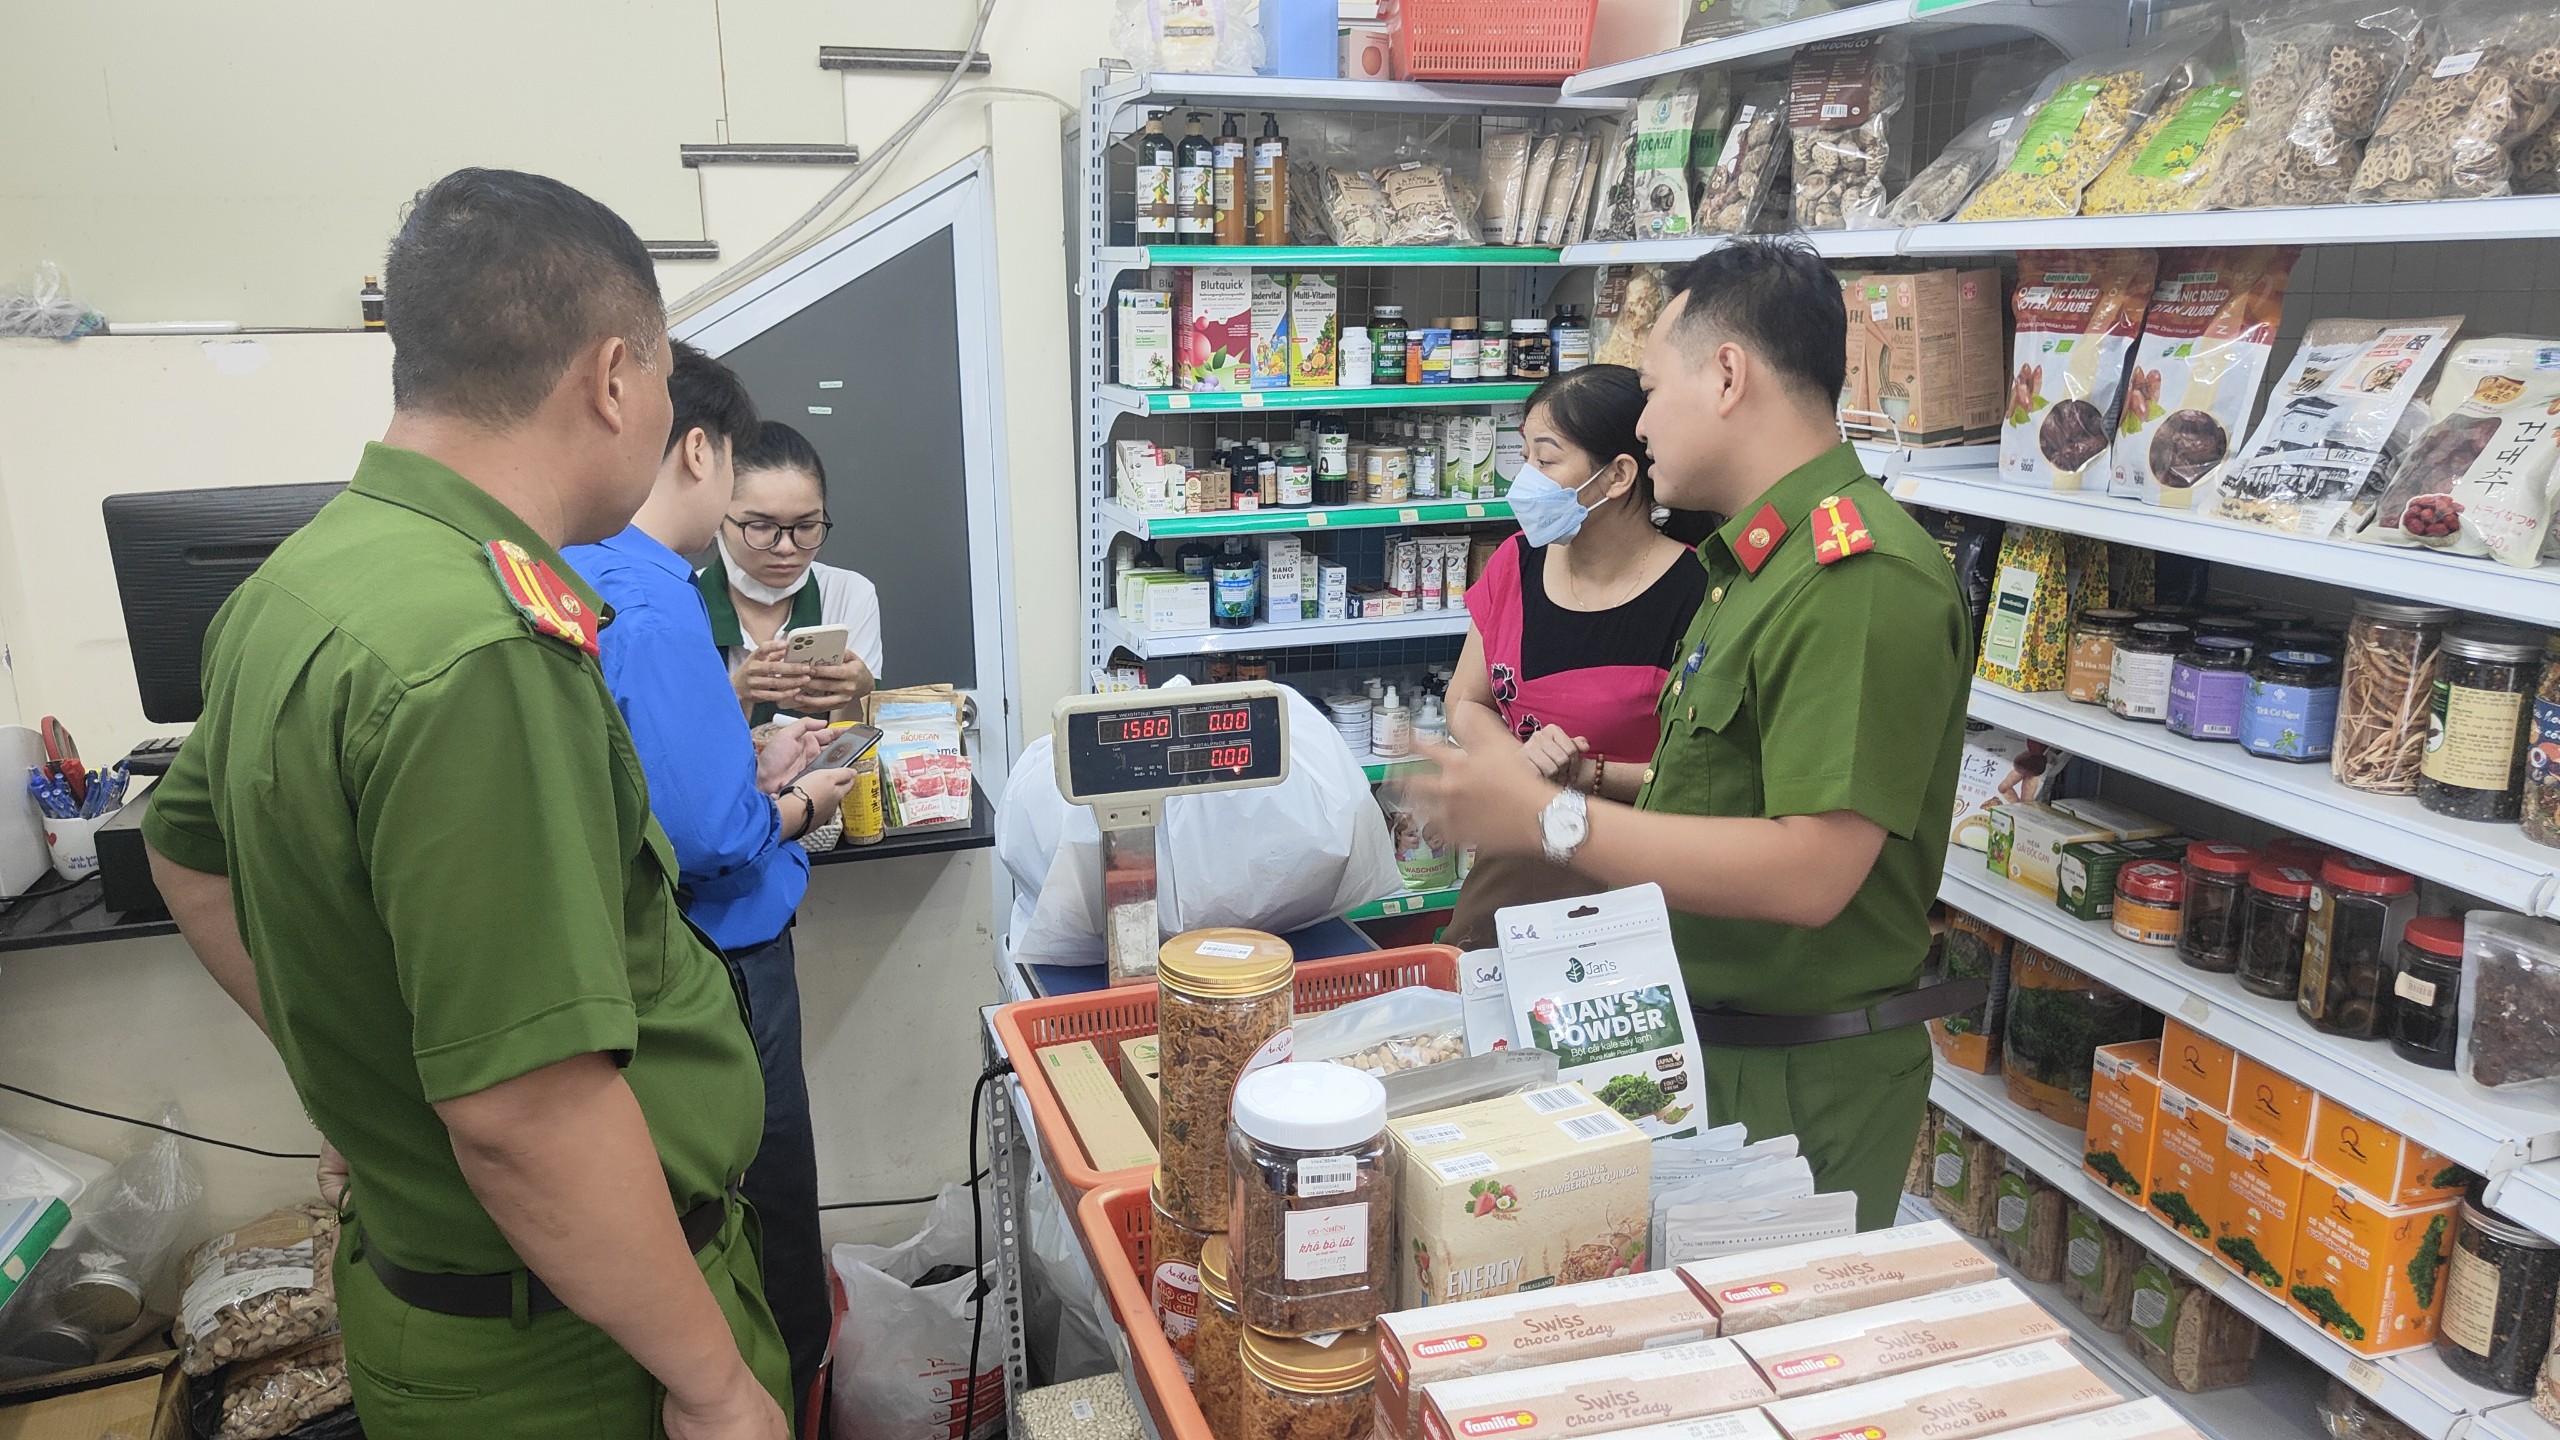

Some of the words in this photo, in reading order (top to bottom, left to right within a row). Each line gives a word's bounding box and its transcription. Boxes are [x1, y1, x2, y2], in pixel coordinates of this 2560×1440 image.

[1201, 280, 1244, 290] Blutquick
[2019, 287, 2068, 298] ONIC
[2068, 288, 2099, 299] DRIED
[1293, 291, 1336, 301] Multi-Vitamin
[2200, 289, 2229, 302] DRIED
[2051, 302, 2092, 313] JUJUBE
[2181, 305, 2220, 317] JUJUBE
[1388, 331, 1405, 339] PINES
[1272, 573, 1295, 581] SILVER
[1123, 718, 1169, 739] 1.580
[1209, 711, 1248, 732] 0.00
[1211, 747, 1249, 767] 0.00
[1510, 924, 1541, 940] Sale
[1586, 960, 1617, 976] Jan's
[1563, 991, 1639, 1026] JAN'S
[1549, 1009, 1666, 1050] POWDER
[1601, 1040, 1618, 1051] kale
[1617, 1048, 1638, 1058] Powder
[1657, 1057, 1674, 1066] JAPAN
[1564, 1171, 1571, 1182] 5
[1572, 1163, 1608, 1180] GRAINS,
[1532, 1178, 1594, 1200] STRAWBERRY
[1602, 1164, 1639, 1183] QUINOA
[1299, 1241, 1320, 1253] khô
[1323, 1239, 1336, 1250] bò
[1446, 1255, 1523, 1298] ENERGY
[1816, 1261, 1875, 1281] Swiss
[1520, 1277, 1555, 1292] BAKALLAND
[1813, 1278, 1856, 1295] Choco
[1860, 1269, 1905, 1287] Teddy
[1724, 1286, 1769, 1302] familia
[1523, 1312, 1585, 1334] Swiss
[1513, 1331, 1560, 1349] Choco
[1568, 1323, 1616, 1342] Teddy
[1874, 1328, 1937, 1350] Swiss
[1416, 1339, 1468, 1356] familia
[1878, 1348, 1924, 1365] Choco
[1928, 1340, 1959, 1354] Bits
[1775, 1358, 1827, 1375] familia
[1574, 1390, 1641, 1413] Swiss
[1917, 1396, 1983, 1421] Swiss
[1565, 1409, 1613, 1427] Choco
[1618, 1402, 1672, 1420] Teddy
[1921, 1419, 1970, 1437] Choco
[1974, 1409, 2008, 1425] Bits
[1464, 1416, 1517, 1433] familia
